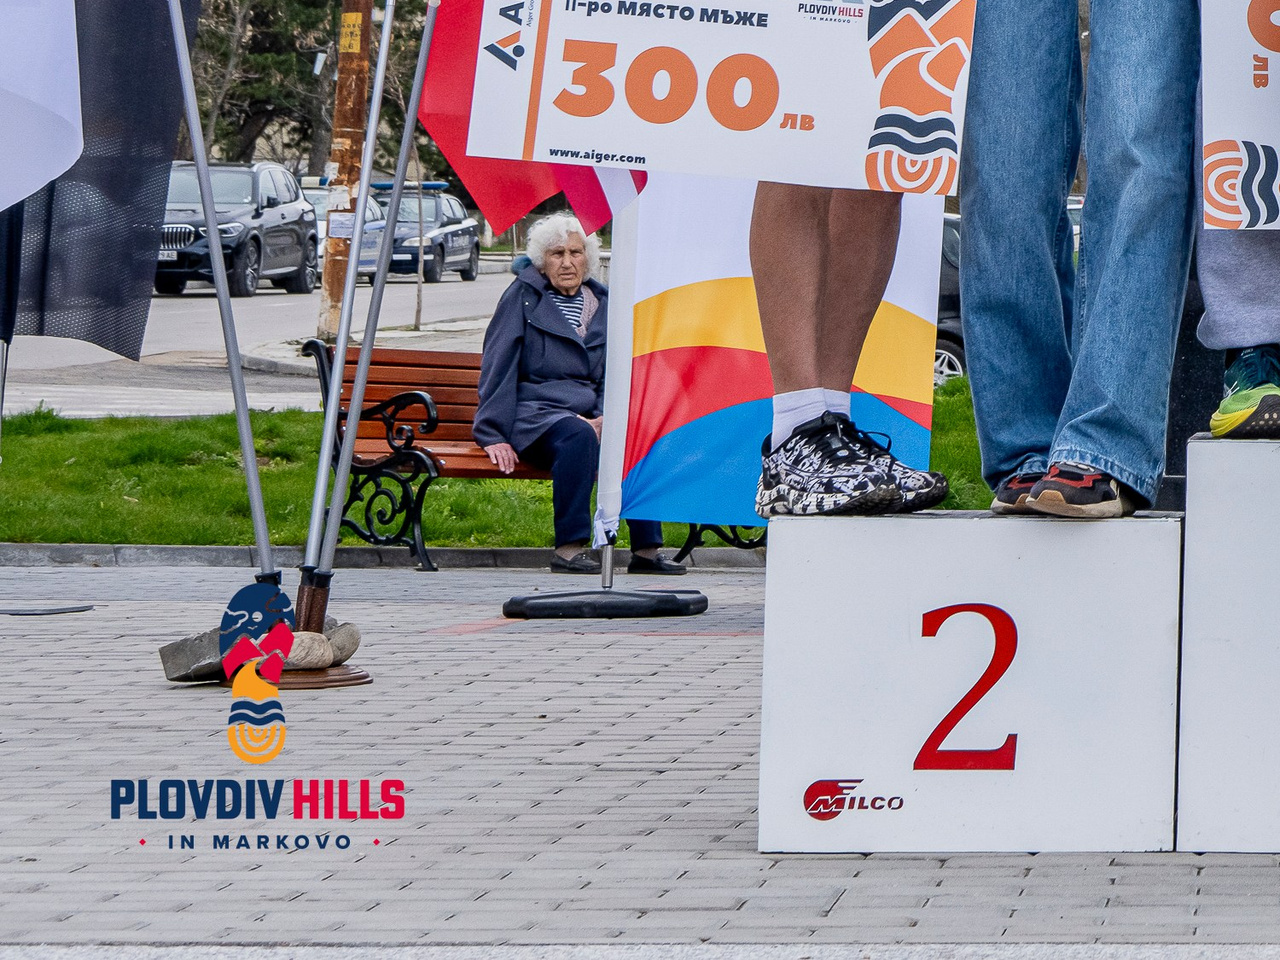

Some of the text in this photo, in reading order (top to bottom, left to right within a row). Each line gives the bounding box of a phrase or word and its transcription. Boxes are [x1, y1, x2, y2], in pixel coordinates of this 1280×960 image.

[526, 10, 534, 27] Aiger
[617, 0, 694, 23] МЯСТО
[699, 6, 768, 28] МЪЖЕ
[798, 3, 863, 18] PLOVDIV HILLS
[1252, 54, 1269, 89] лв
[552, 39, 815, 131] 300 лв
[549, 147, 646, 165] www.aiger.com
[913, 603, 1018, 770] 2
[807, 795, 904, 813] MILCO
